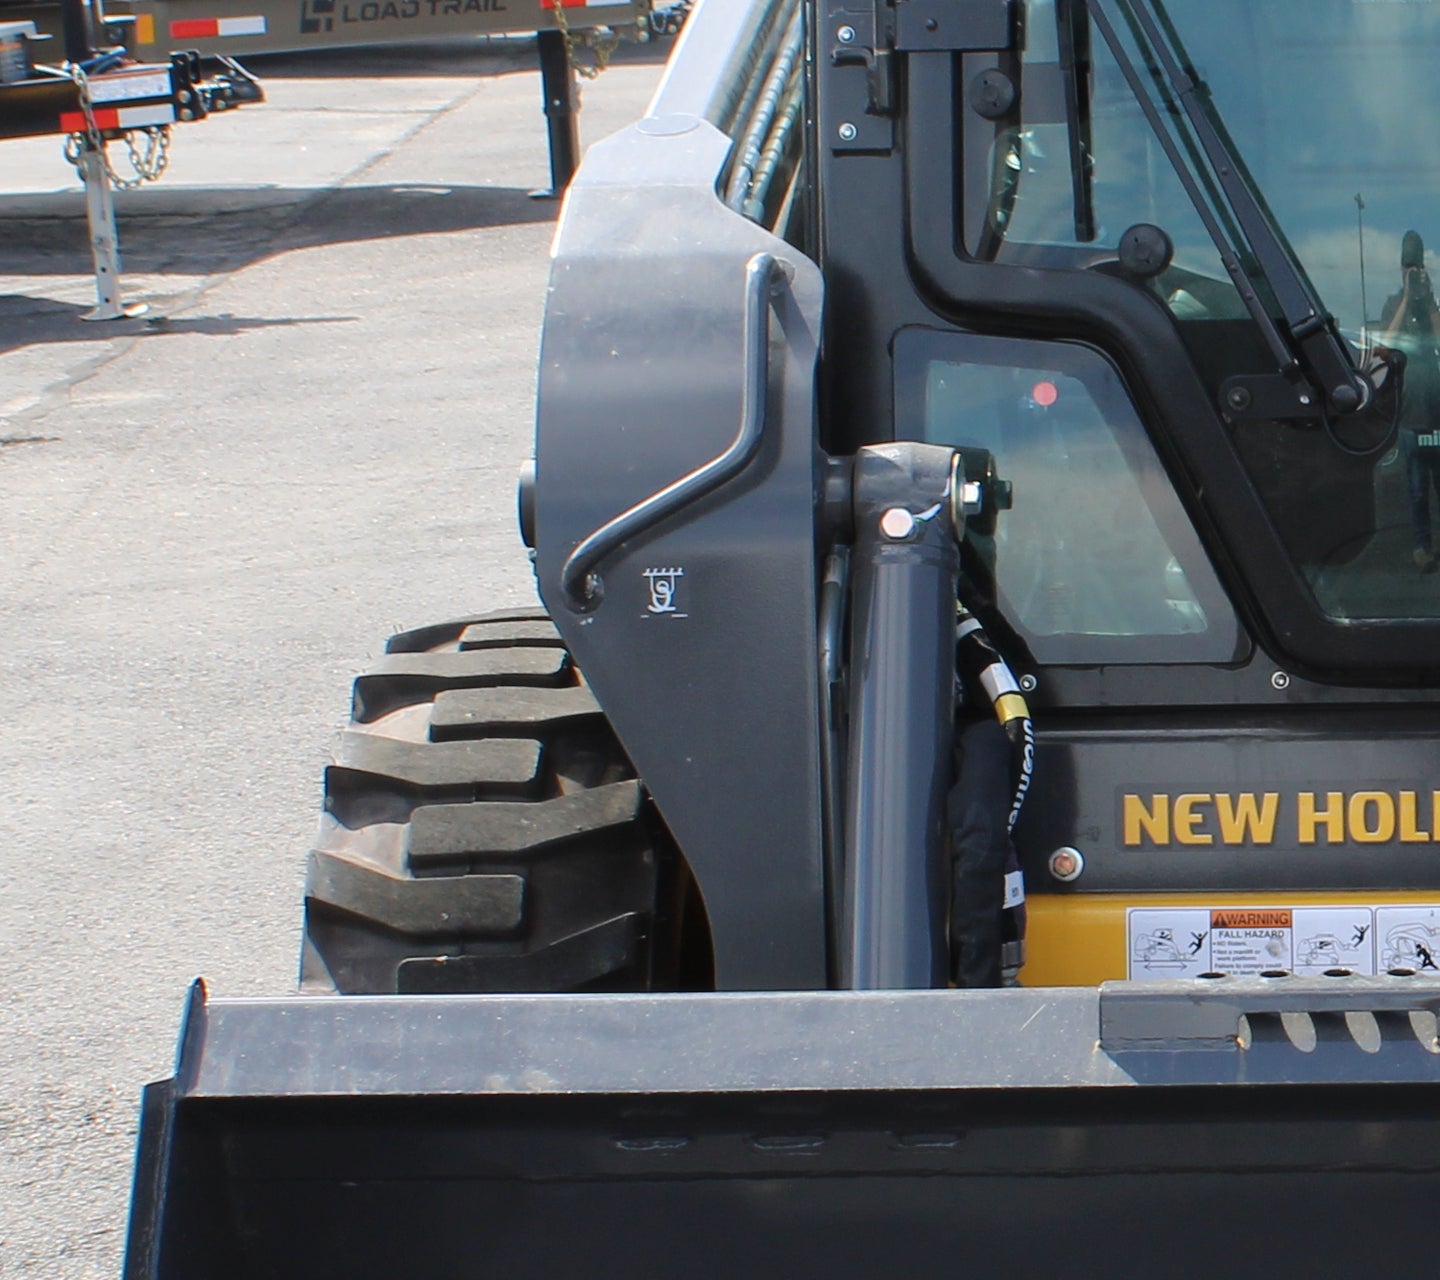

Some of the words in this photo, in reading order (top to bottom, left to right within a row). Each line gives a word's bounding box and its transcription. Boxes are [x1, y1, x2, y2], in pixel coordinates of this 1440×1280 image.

[341, 0, 421, 23] LOAD
[1122, 790, 1280, 847] NEW
[1227, 912, 1289, 925] WARNING
[1218, 930, 1242, 939] FALL
[1244, 930, 1285, 938] HAZARD
